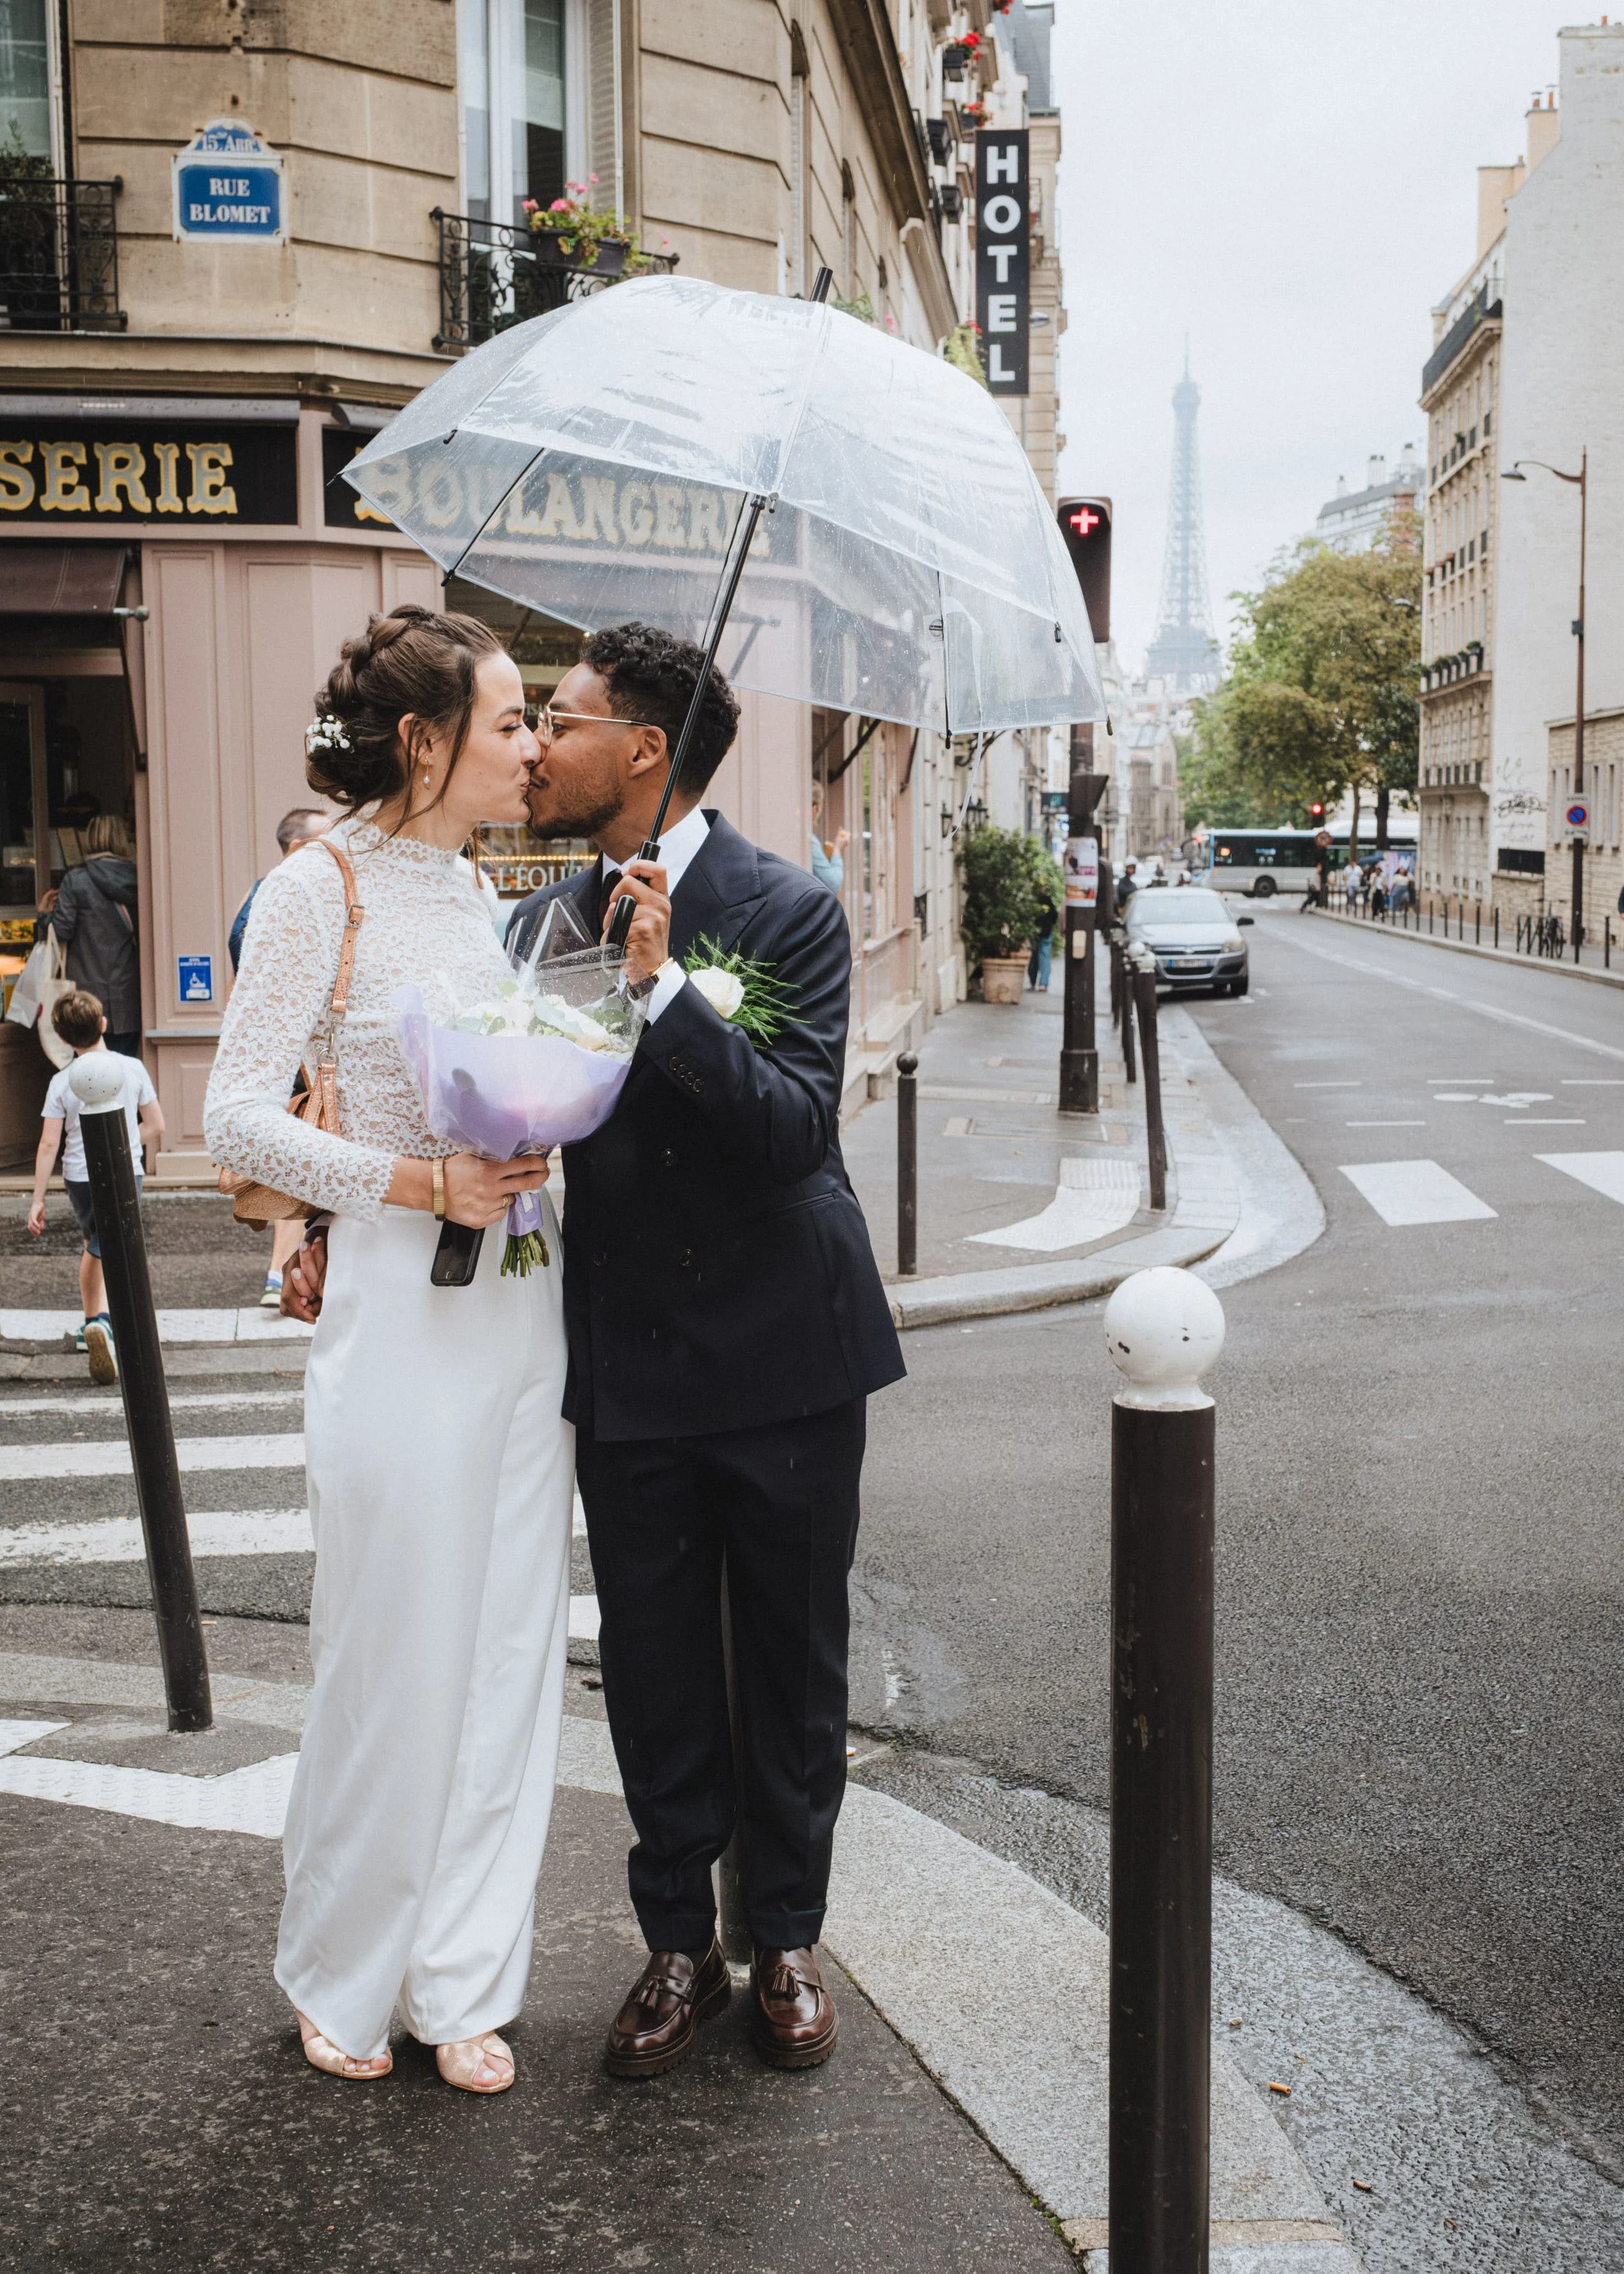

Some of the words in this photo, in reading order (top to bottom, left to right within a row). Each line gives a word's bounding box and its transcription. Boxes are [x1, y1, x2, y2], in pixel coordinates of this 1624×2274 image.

[209, 177, 251, 197] RUE
[189, 203, 271, 224] BLOMET
[983, 145, 1021, 381] HOTEL
